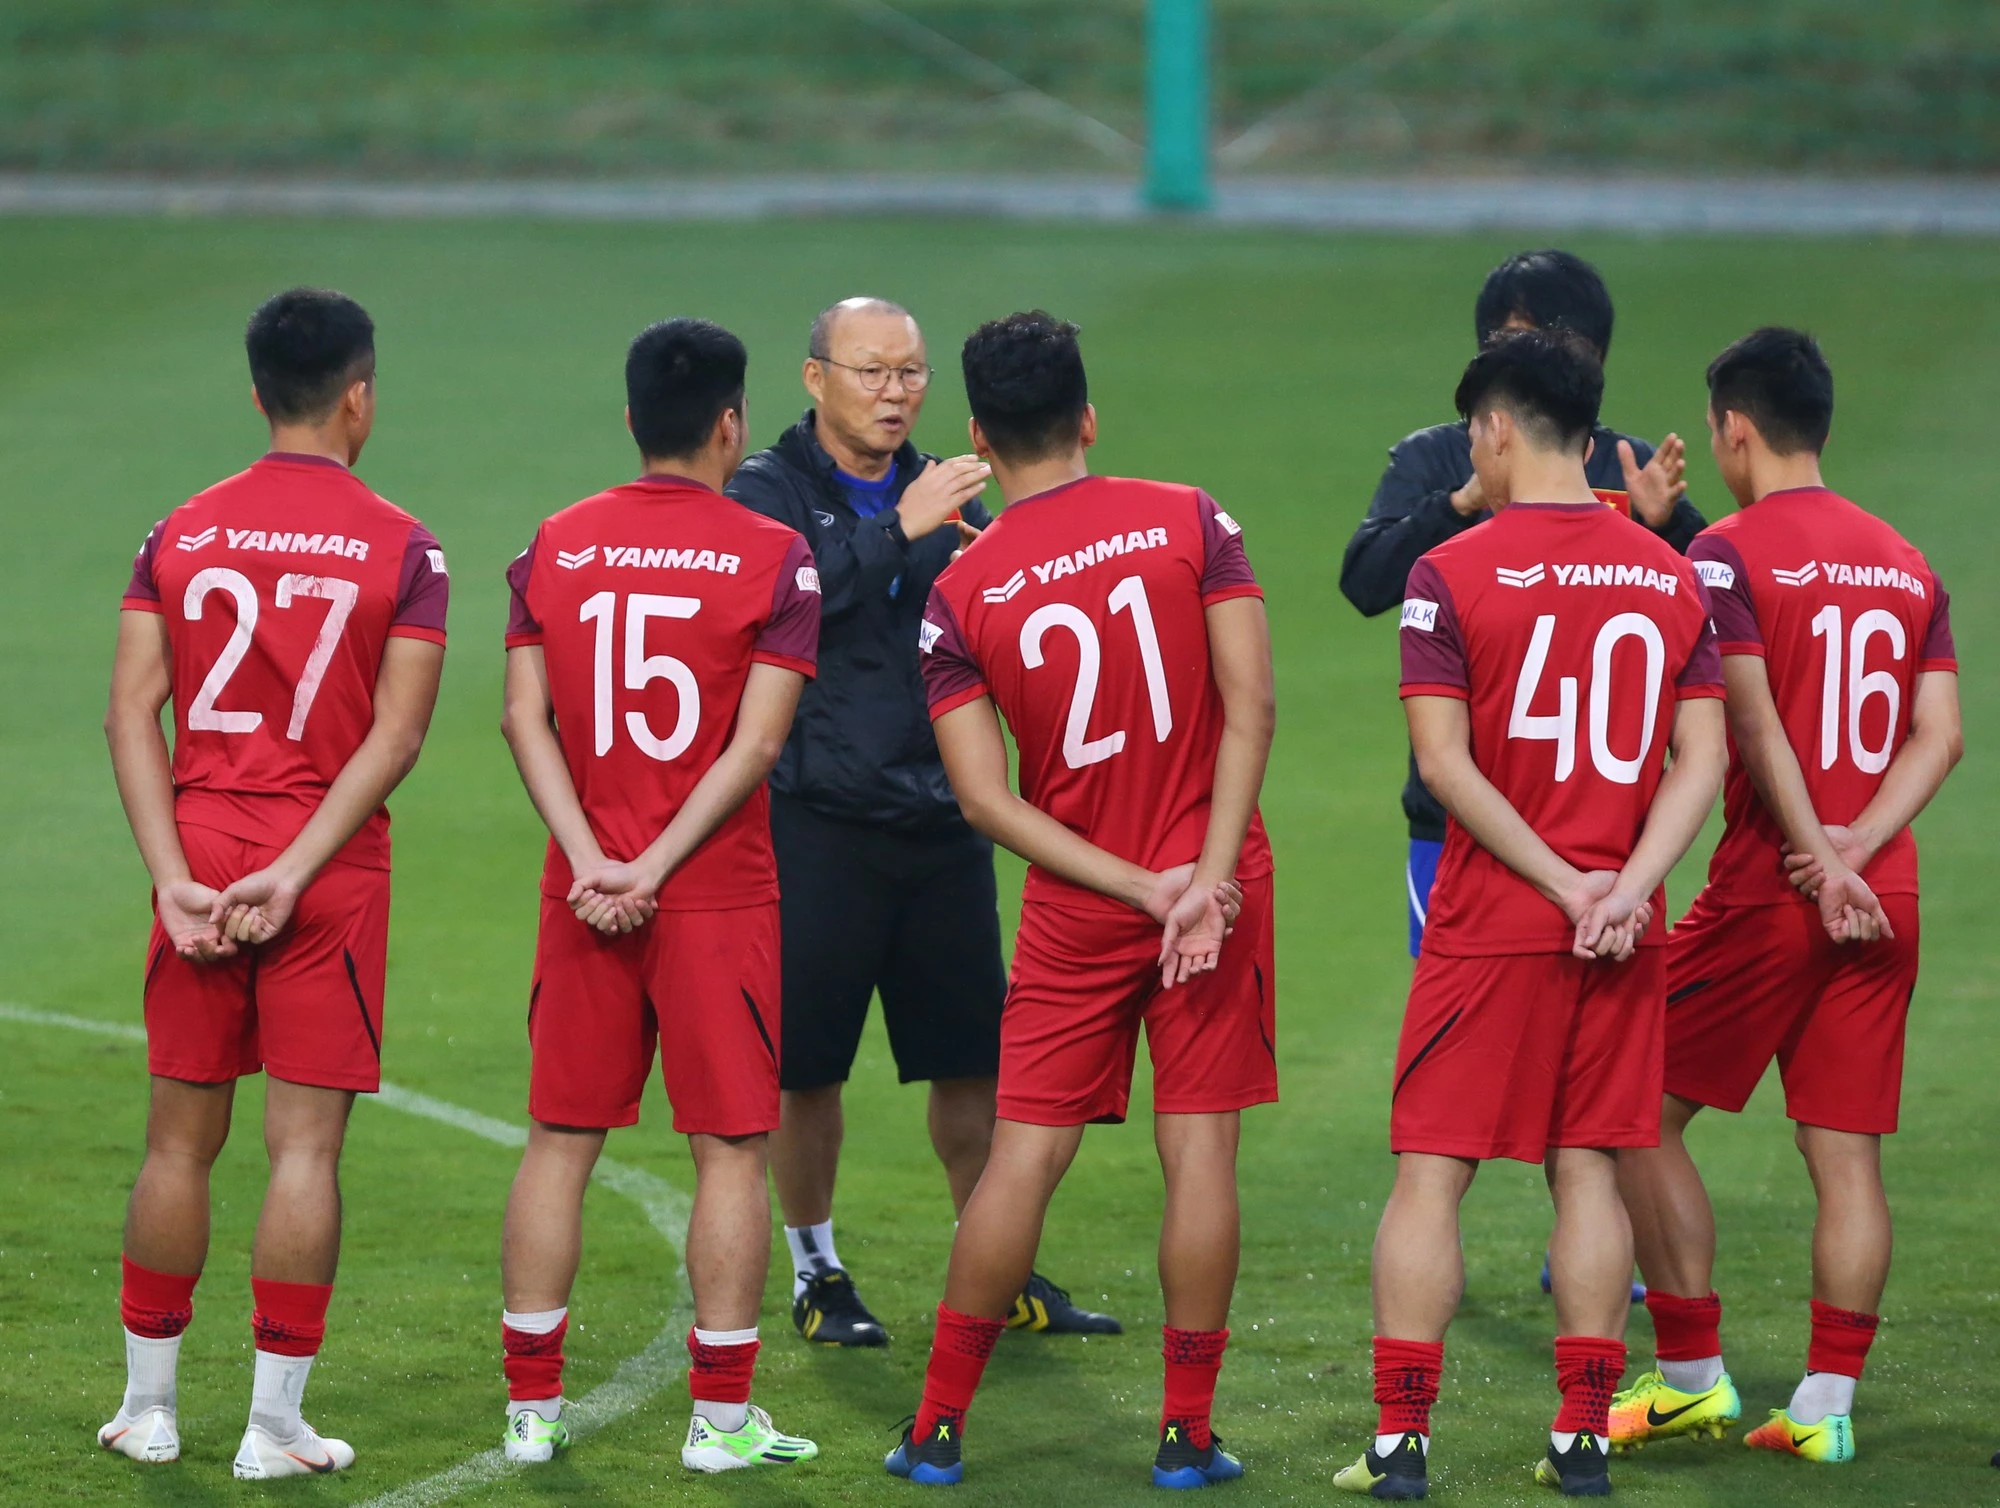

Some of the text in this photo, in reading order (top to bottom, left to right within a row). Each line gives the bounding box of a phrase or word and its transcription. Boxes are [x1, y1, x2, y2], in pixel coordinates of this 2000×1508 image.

[225, 528, 370, 562] YANMAR
[602, 546, 740, 575] YANMAR
[1031, 527, 1168, 585] YANMAR
[1552, 564, 1679, 597] YANMAR
[1821, 561, 1926, 600] YANMAR
[183, 566, 360, 742] 27
[579, 591, 702, 762] 15
[1019, 575, 1173, 770] 21
[1507, 612, 1666, 785] 40
[1811, 604, 1906, 775] 16
